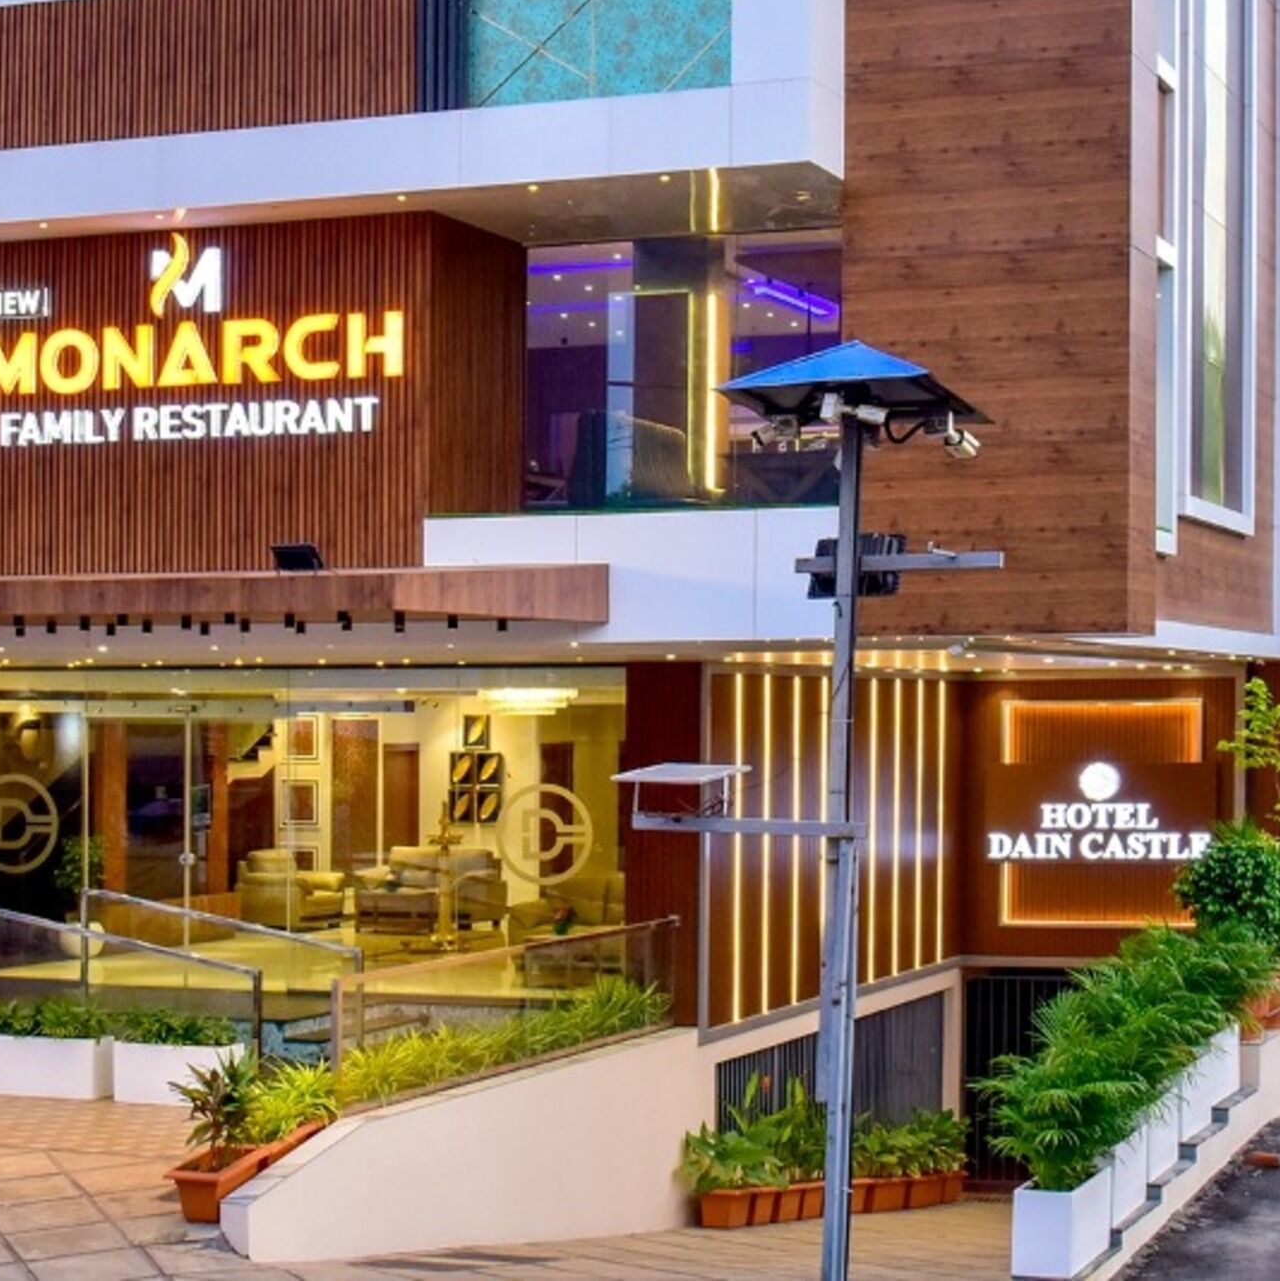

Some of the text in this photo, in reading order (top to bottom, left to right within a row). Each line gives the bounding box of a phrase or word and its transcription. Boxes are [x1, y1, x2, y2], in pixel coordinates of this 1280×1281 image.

[0, 396, 380, 447] FAMILY RESTAURANT
[1040, 803, 1158, 829] HOTEL
[988, 833, 1071, 859] DAIN
